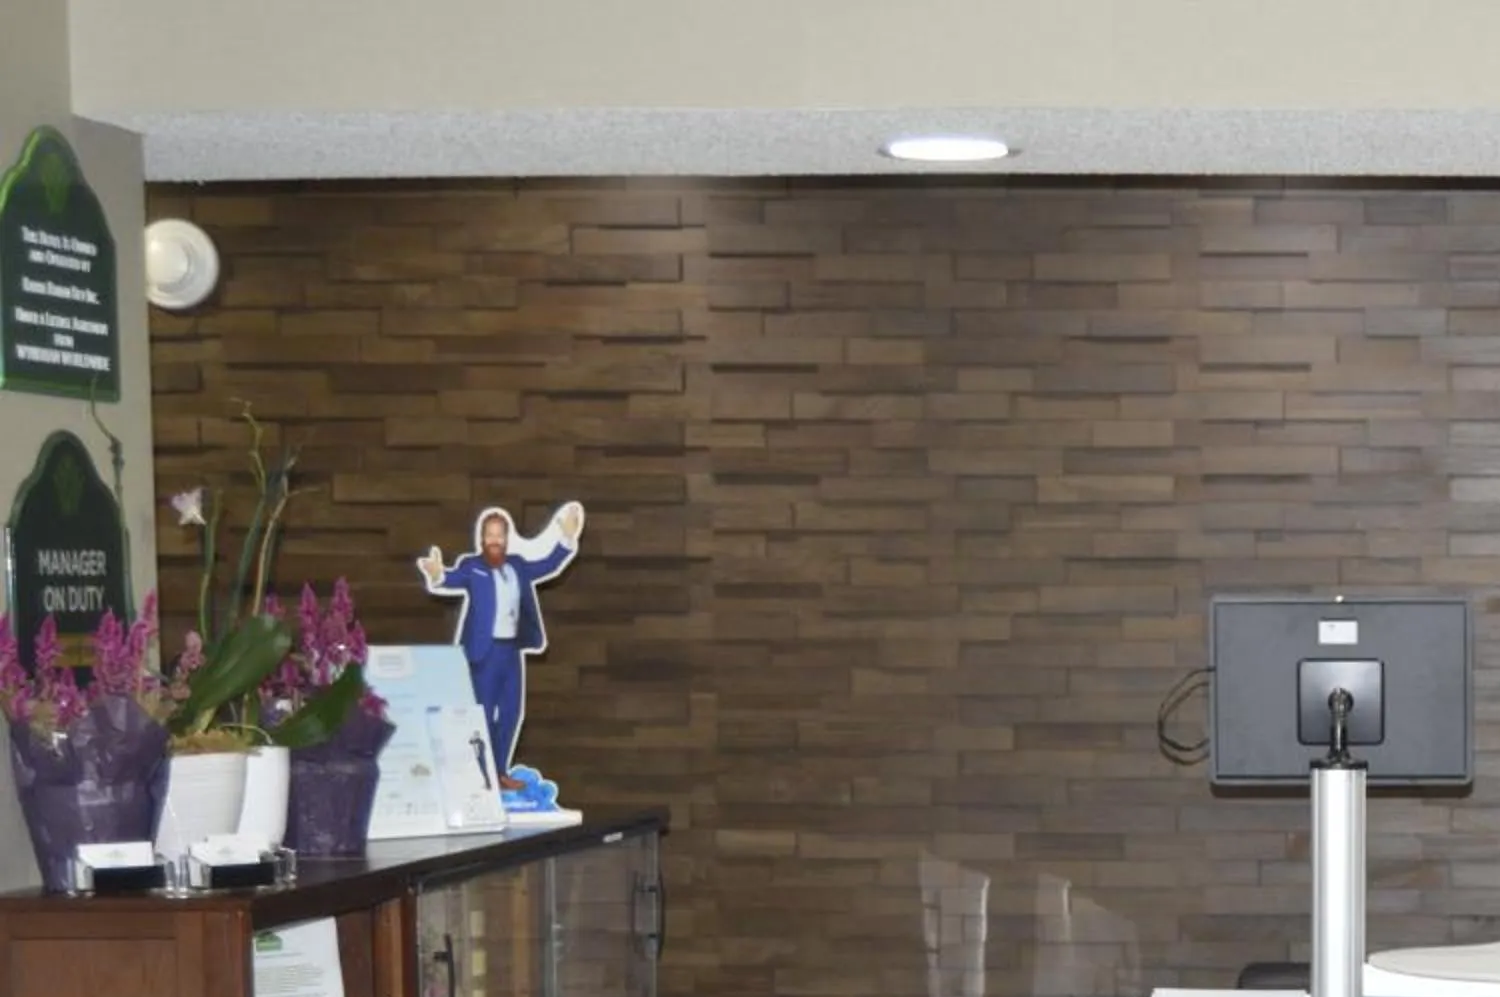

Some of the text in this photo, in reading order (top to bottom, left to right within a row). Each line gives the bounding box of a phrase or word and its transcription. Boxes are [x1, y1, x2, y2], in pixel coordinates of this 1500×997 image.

[38, 549, 107, 577] MANAGER
[43, 584, 105, 613] ON DUTY
